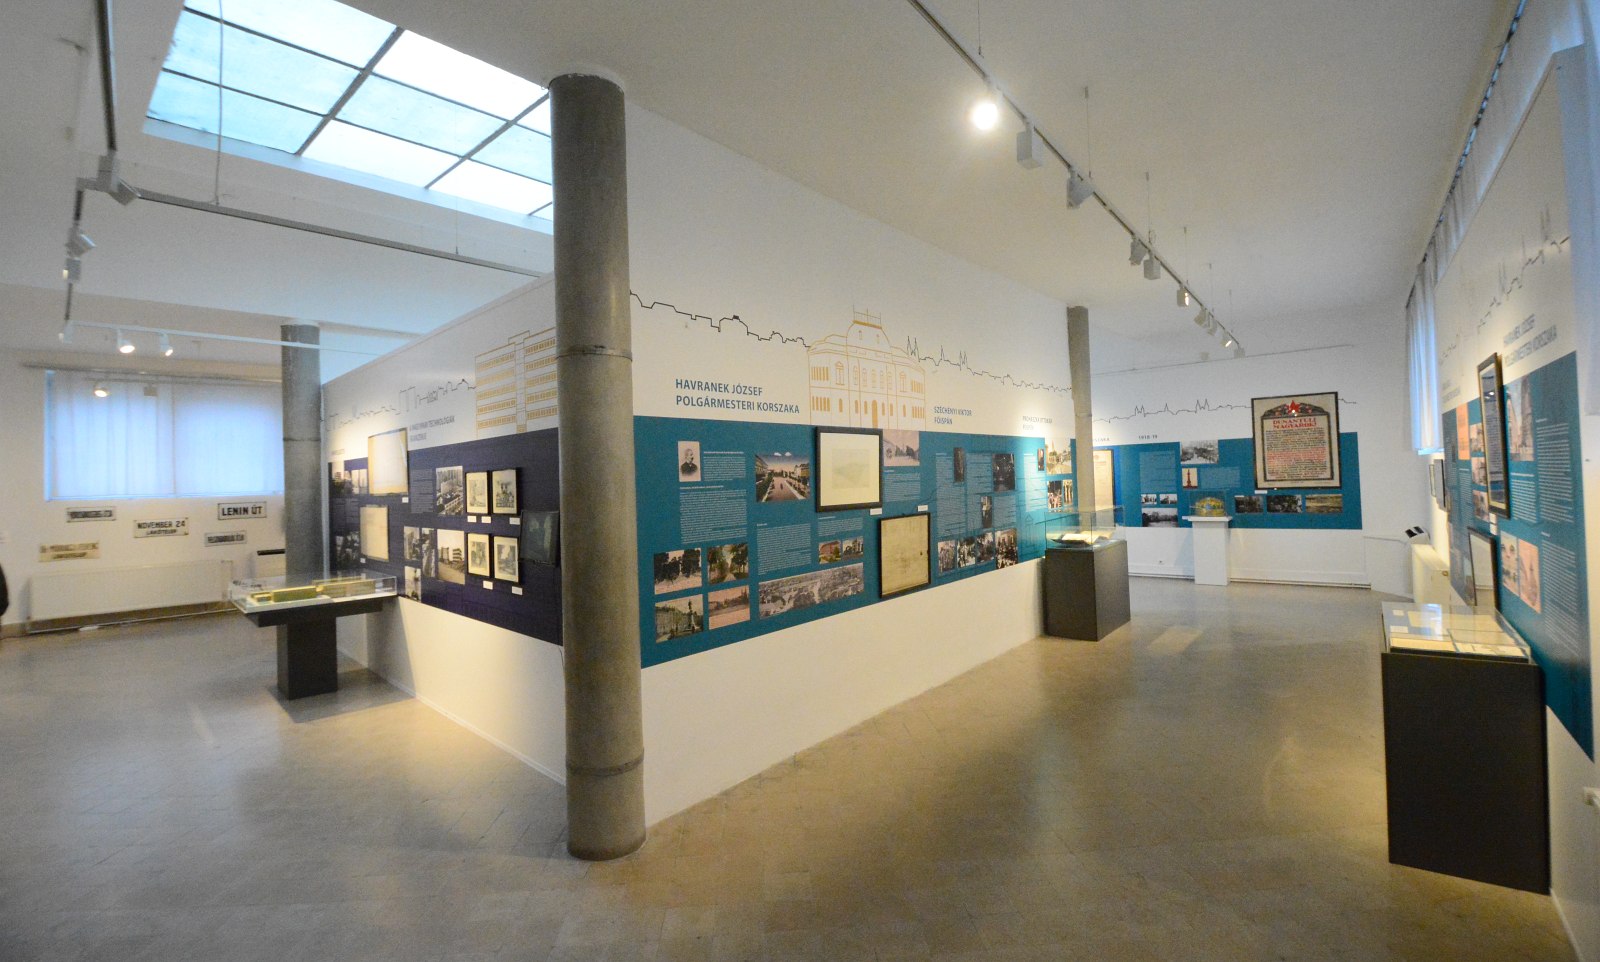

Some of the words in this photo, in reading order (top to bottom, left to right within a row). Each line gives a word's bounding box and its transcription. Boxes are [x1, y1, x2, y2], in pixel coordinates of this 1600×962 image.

[675, 378, 729, 394] HAVRANEK
[731, 383, 763, 396] JÓZSEF
[676, 395, 755, 411] POLGÁRMESTERI
[757, 402, 800, 414] KORSZAKA
[221, 506, 249, 516] LENIN
[137, 521, 173, 529] NOVEMBER
[175, 520, 186, 528] 24
